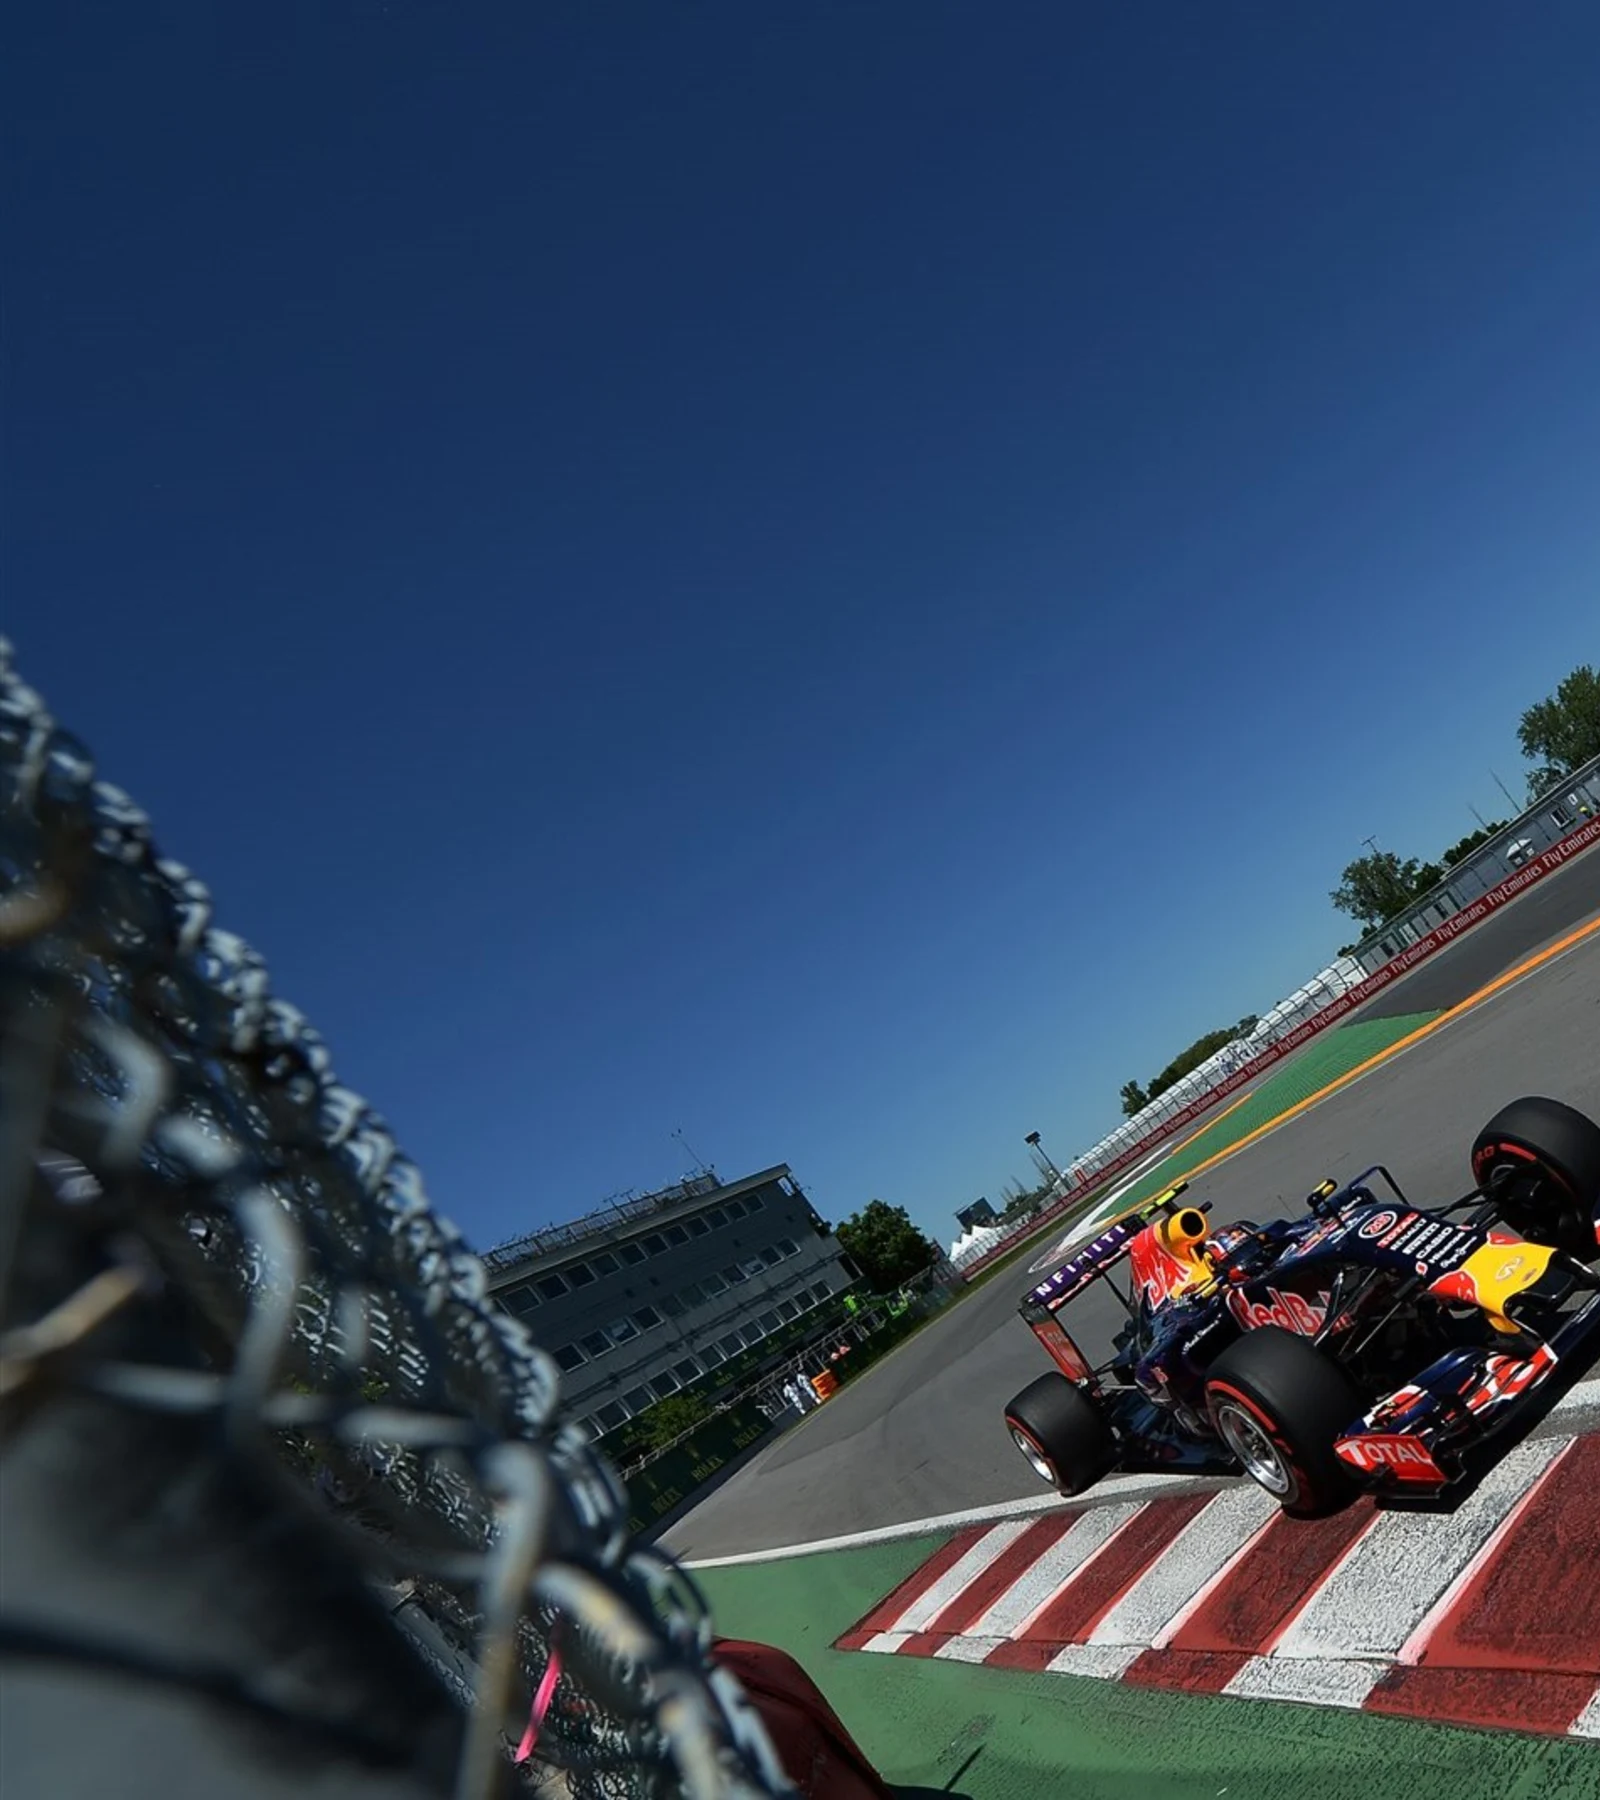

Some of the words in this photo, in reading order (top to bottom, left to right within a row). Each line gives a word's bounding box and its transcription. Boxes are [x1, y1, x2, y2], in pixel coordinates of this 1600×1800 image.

[1541, 848, 1563, 868] Fly
[1486, 889, 1506, 906] Fly
[1501, 864, 1543, 896] Emirates
[1415, 1226, 1454, 1259] CASIO
[1336, 1440, 1433, 1466] TOTAL
